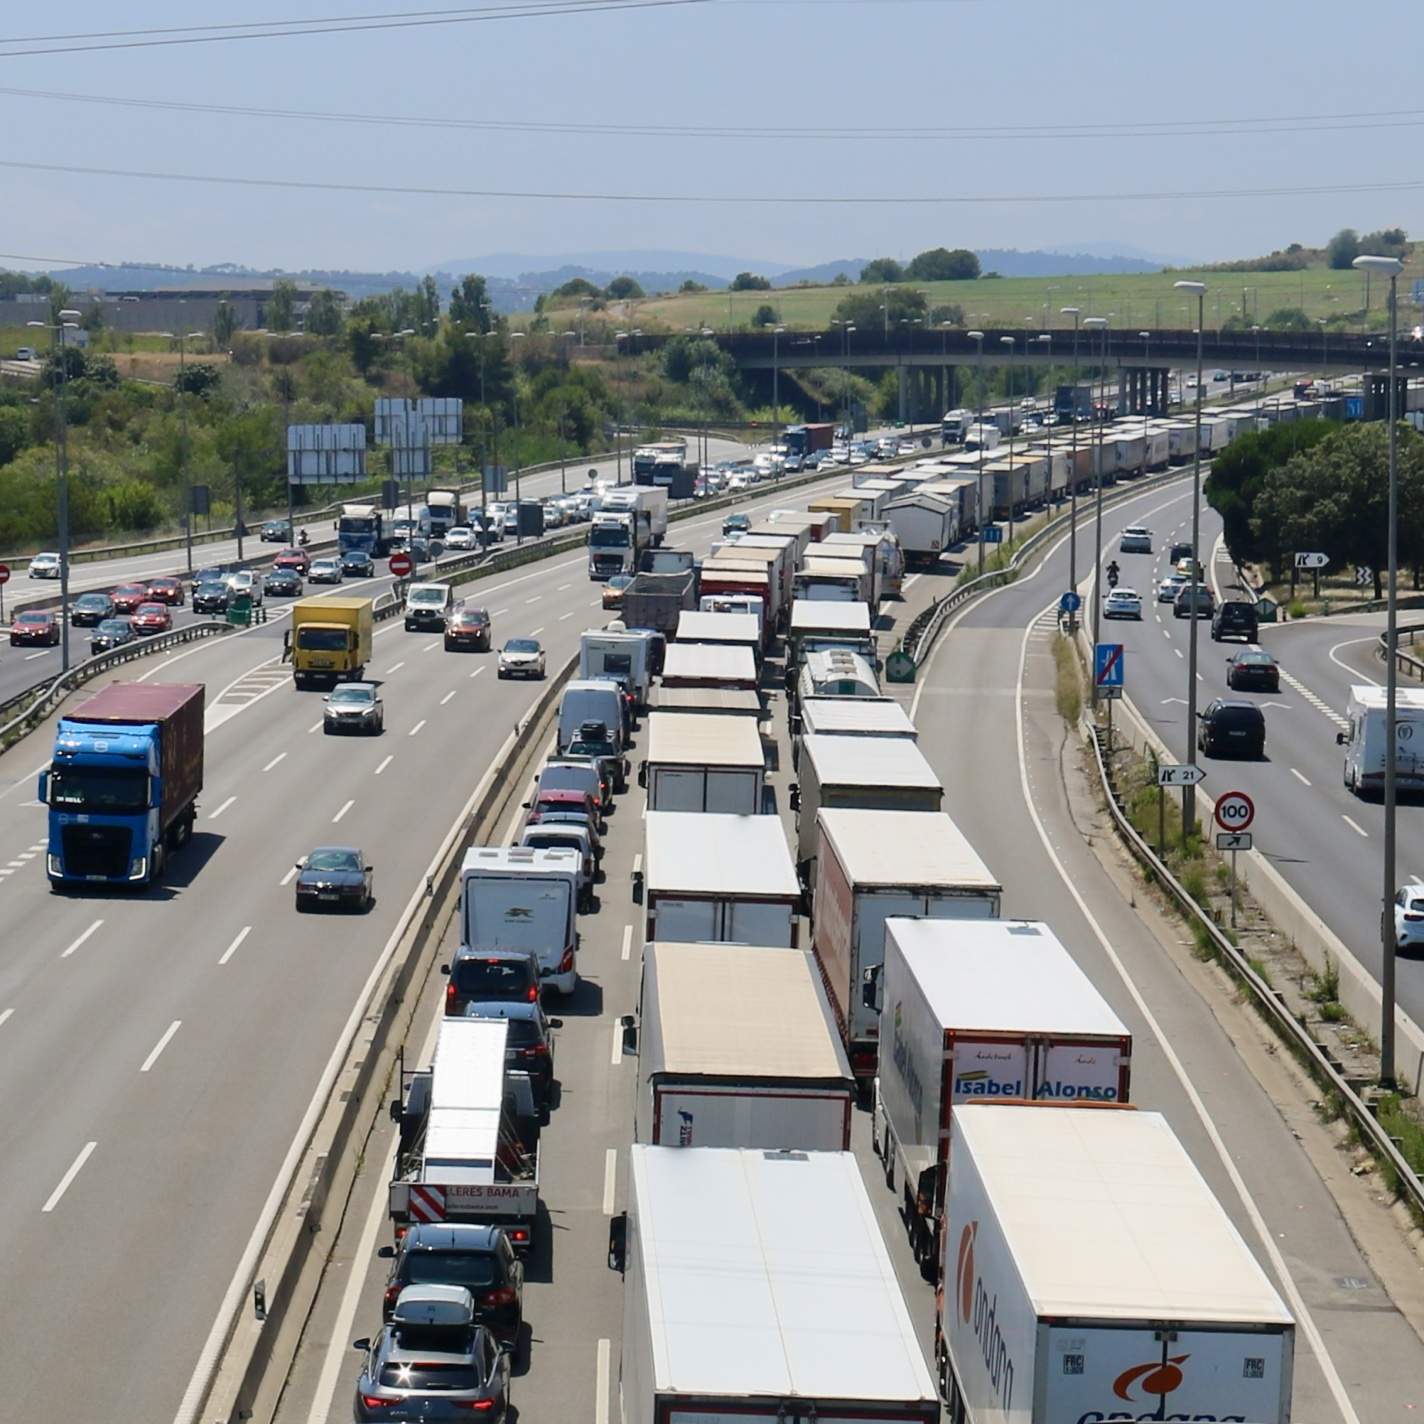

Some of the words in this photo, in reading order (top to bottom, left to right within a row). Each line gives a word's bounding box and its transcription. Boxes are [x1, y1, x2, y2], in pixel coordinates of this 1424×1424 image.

[1182, 770, 1194, 780] 21
[1221, 804, 1249, 818] 100
[955, 1078, 1022, 1096] Isabel
[1037, 1080, 1117, 1099] Alonso
[487, 1187, 519, 1198] BAMA
